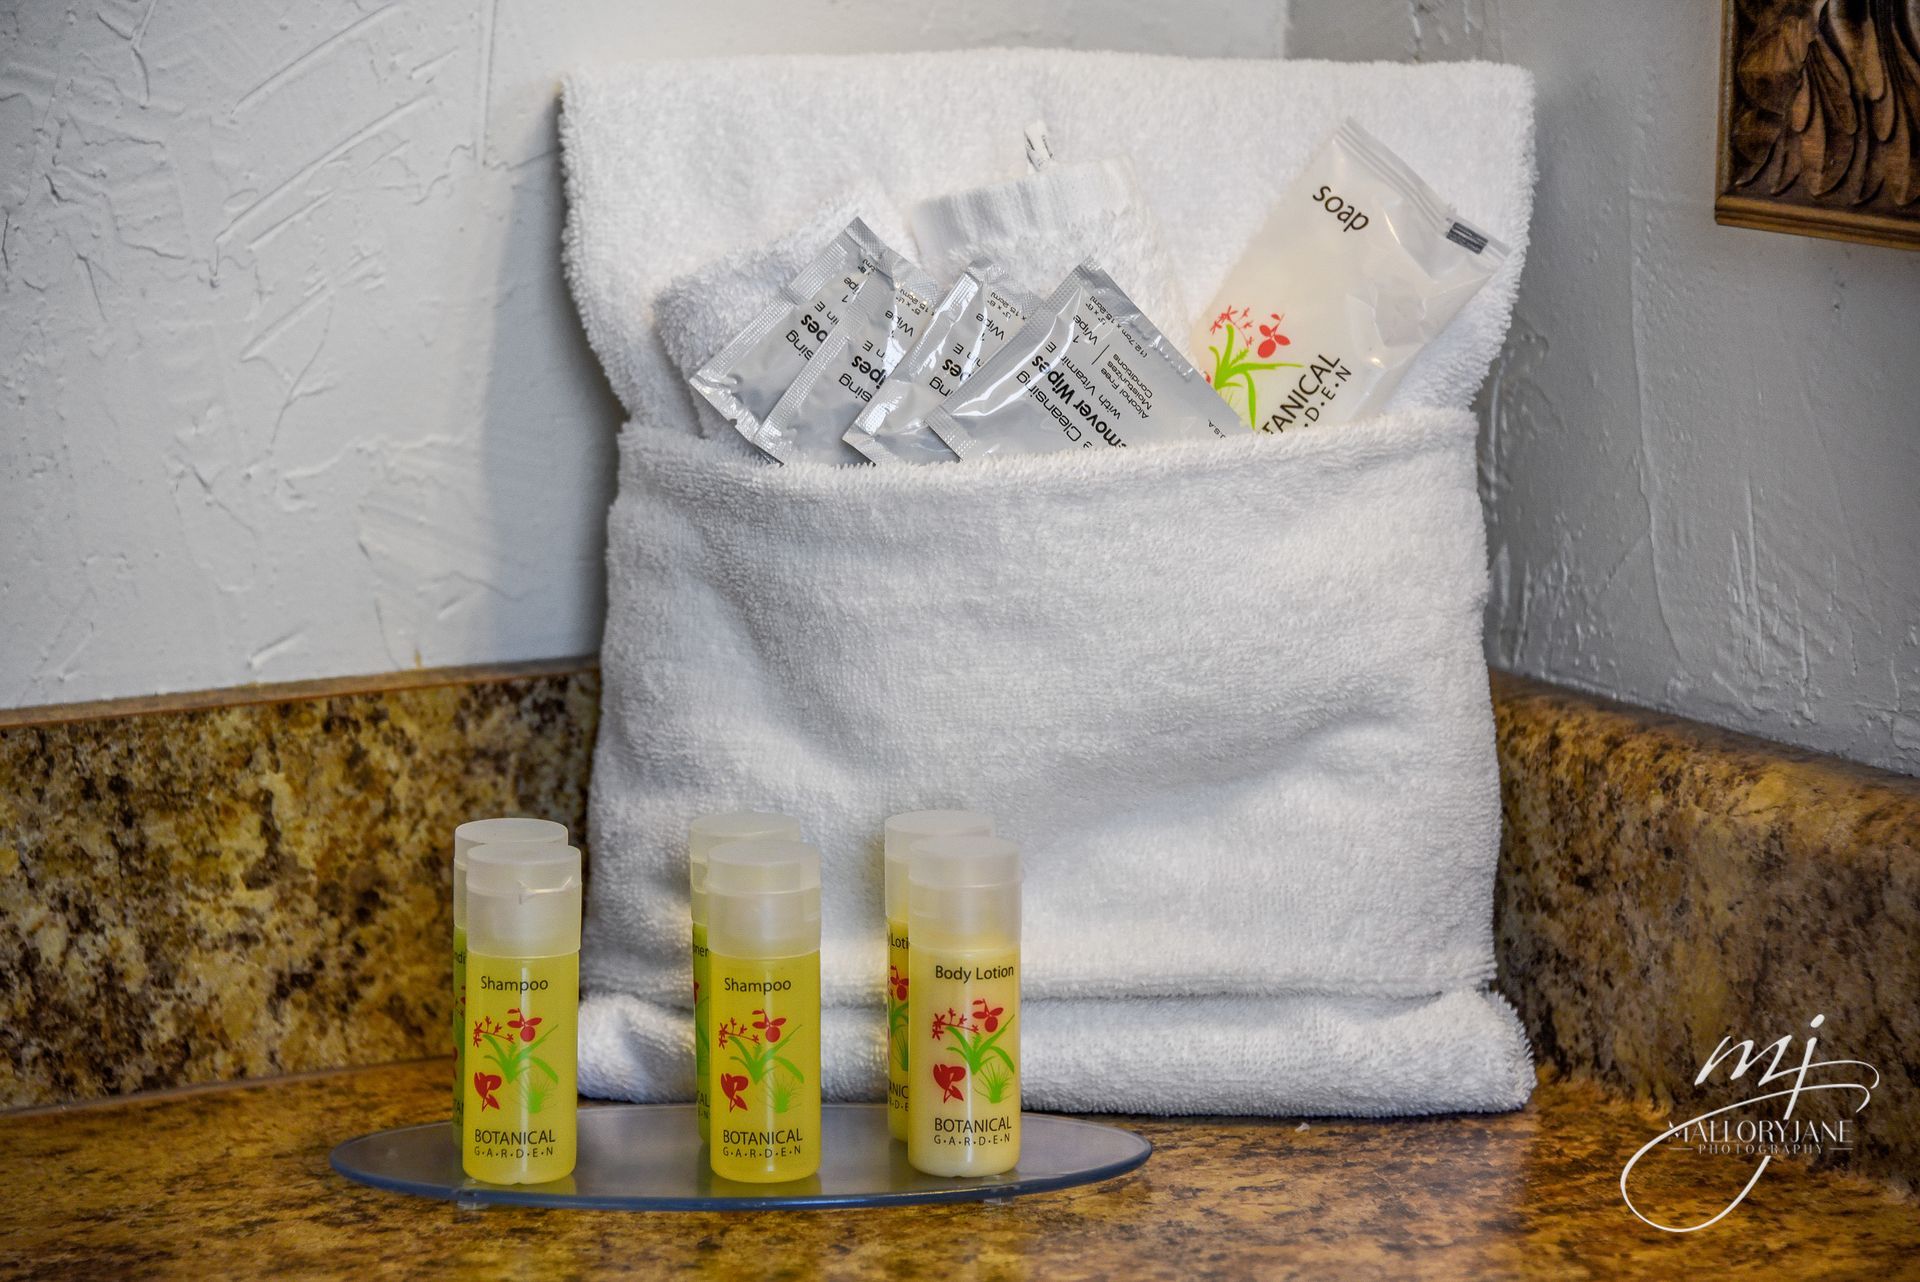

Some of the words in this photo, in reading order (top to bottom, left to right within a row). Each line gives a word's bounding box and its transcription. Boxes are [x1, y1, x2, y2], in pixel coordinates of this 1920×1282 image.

[1311, 184, 1370, 232] soap
[1072, 314, 1097, 345] Wipe
[1045, 341, 1056, 353] E
[1031, 355, 1075, 404] Wipes
[1100, 367, 1119, 389] Free
[1101, 360, 1151, 410] Moisturizes
[1107, 353, 1152, 398] Conditions
[1015, 370, 1081, 441] Cleansing
[1098, 394, 1120, 419] with
[1118, 388, 1149, 418] Alcohol
[480, 975, 550, 993] Shampoo
[724, 977, 792, 993] Shampoo
[935, 965, 972, 984] Body
[976, 965, 1014, 980] Lotion
[474, 1129, 556, 1145] BOTANICAL
[723, 1129, 803, 1145] BOTANICAL
[934, 1118, 1012, 1133] BOTANICAL
